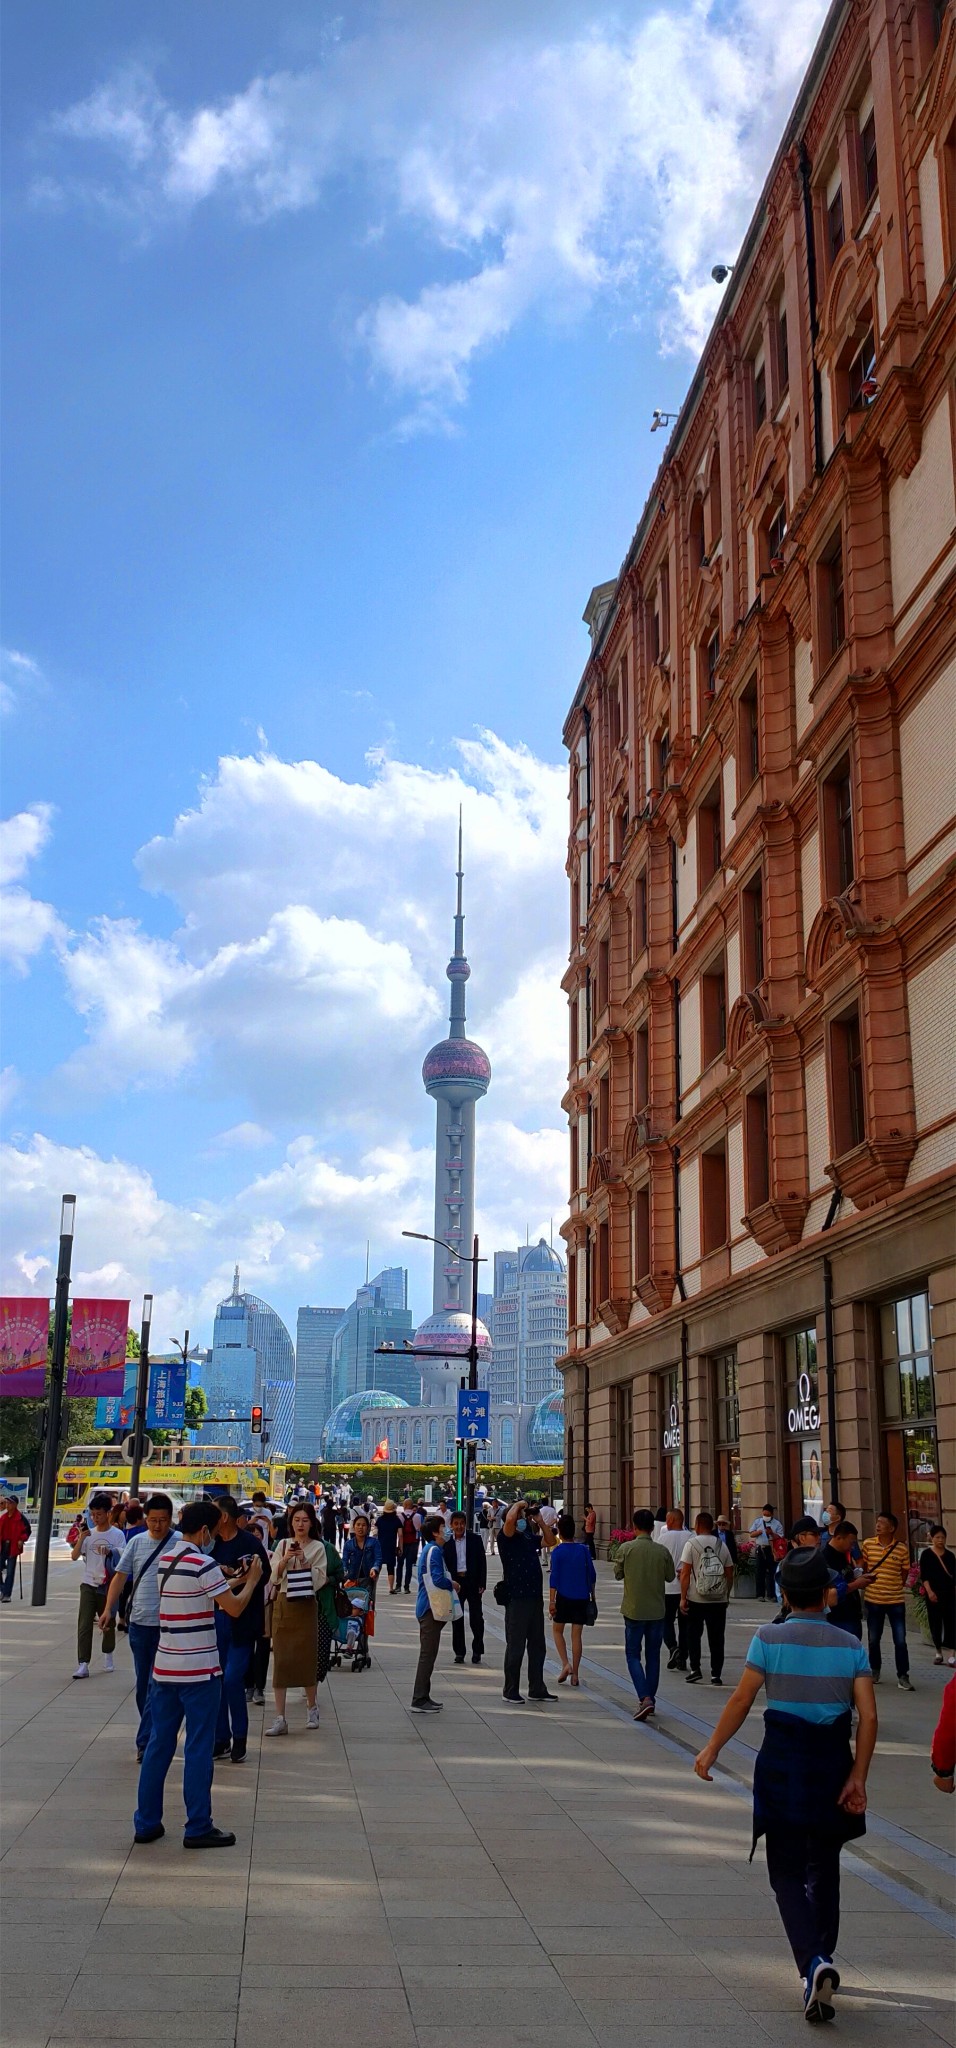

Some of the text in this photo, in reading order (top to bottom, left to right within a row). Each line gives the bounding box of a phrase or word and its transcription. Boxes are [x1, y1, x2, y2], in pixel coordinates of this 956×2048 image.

[155, 1370, 167, 1418] 上海旅游节
[461, 1406, 486, 1418] 外滩
[788, 1405, 821, 1432] OMEG
[663, 1428, 681, 1448] OMEG
